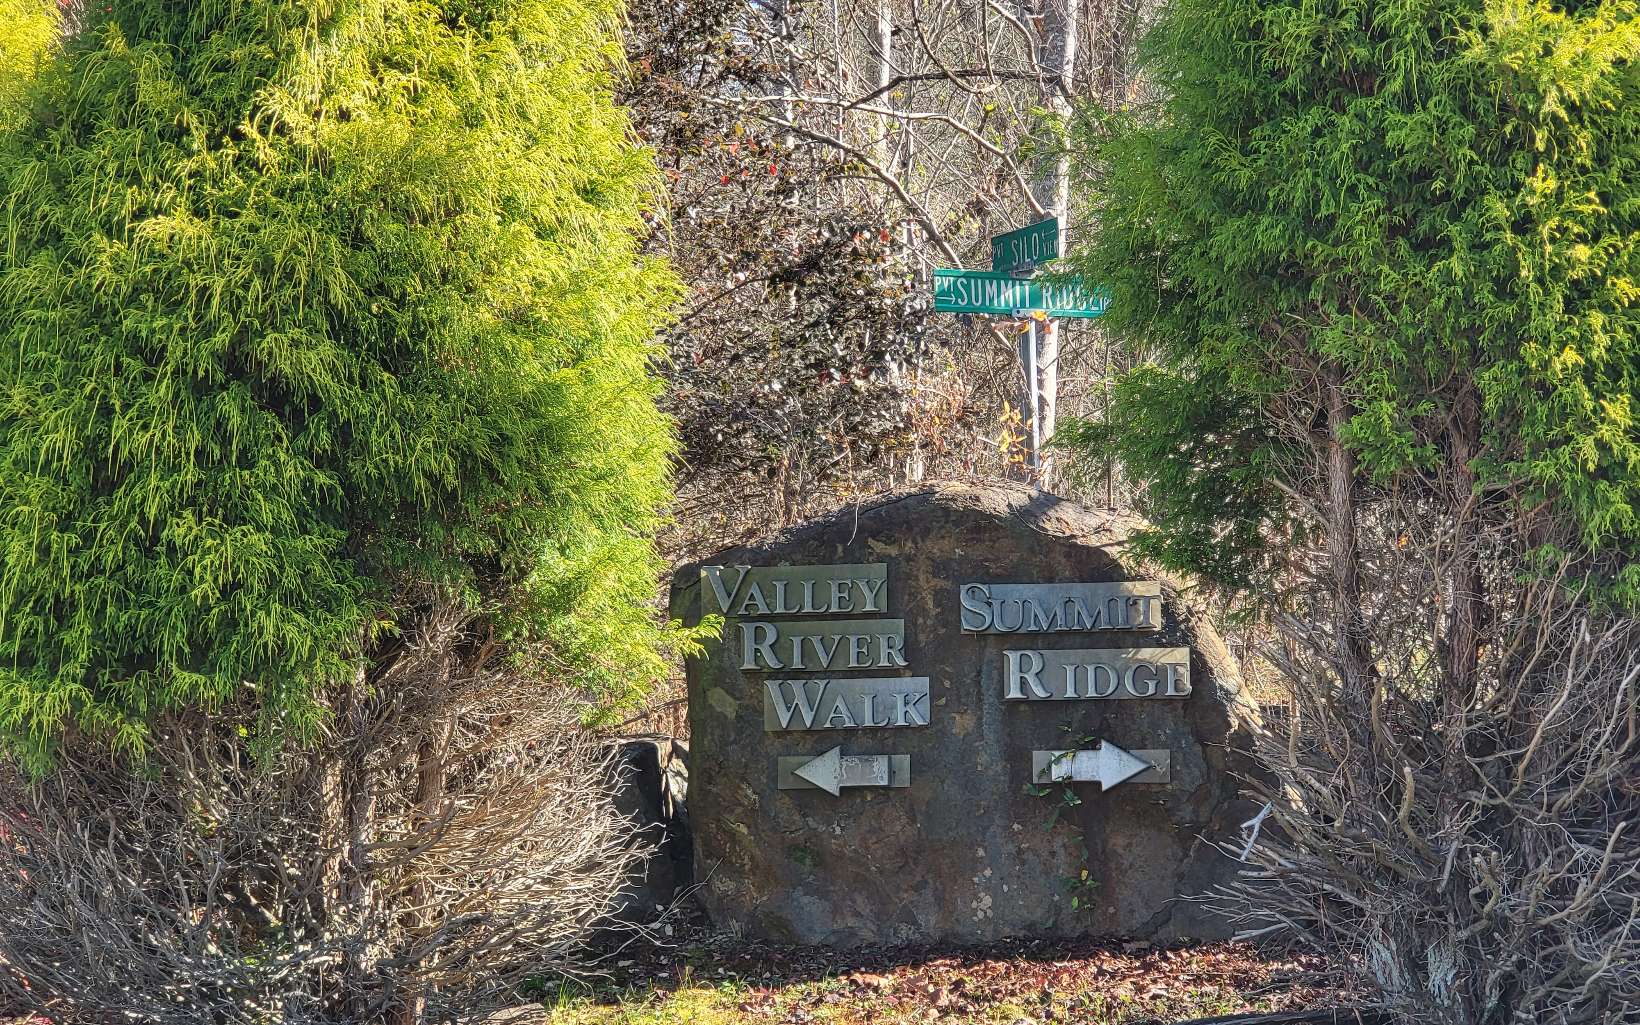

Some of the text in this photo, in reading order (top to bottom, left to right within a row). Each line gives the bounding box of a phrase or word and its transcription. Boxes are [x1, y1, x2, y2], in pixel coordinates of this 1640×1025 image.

[1011, 232, 1039, 266] SILO
[935, 277, 954, 292] PVT
[957, 277, 1031, 308] SUMMIT
[702, 565, 888, 616] VALLEY
[960, 583, 1164, 632] SUMMIT
[739, 621, 910, 670] RIVER
[1003, 650, 1193, 699] RIDGE
[764, 680, 930, 729] WALK
